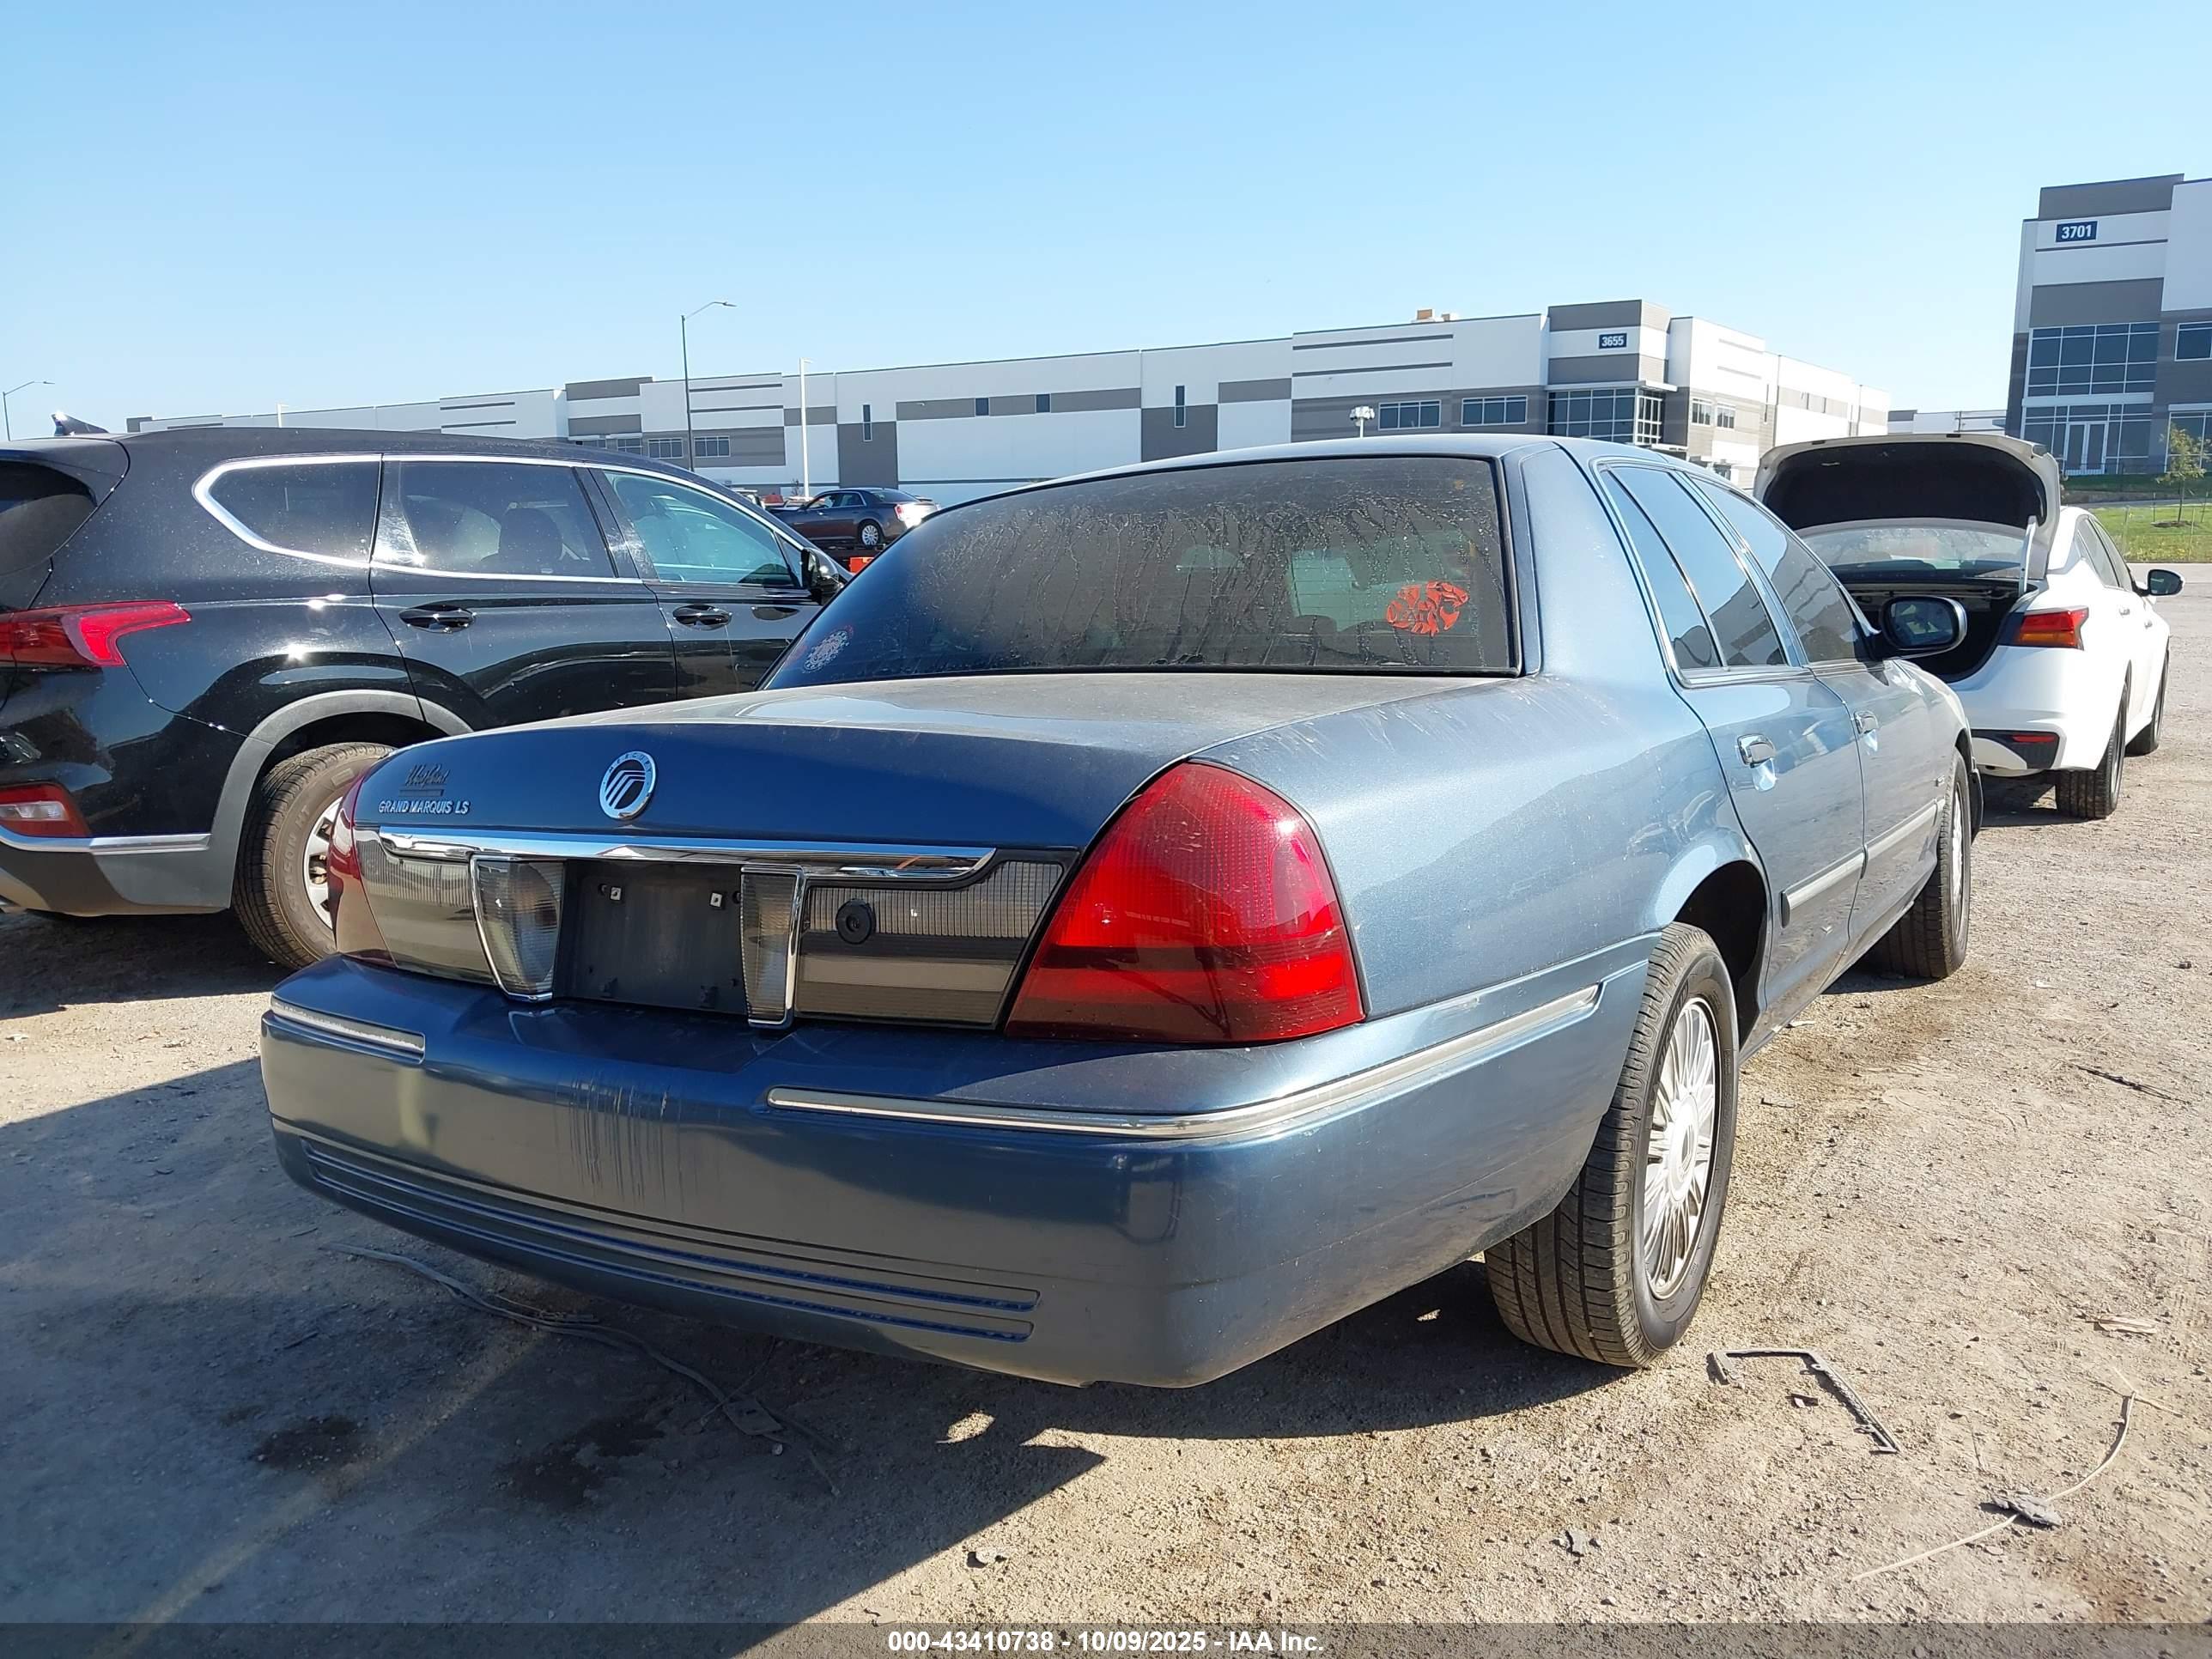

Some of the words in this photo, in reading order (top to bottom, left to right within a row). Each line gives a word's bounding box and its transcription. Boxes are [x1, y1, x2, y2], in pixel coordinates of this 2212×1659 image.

[2061, 224, 2092, 240] 3701
[1601, 336, 1625, 347] 3655
[378, 800, 410, 813] GRAND
[409, 800, 453, 815] MARQUIS
[454, 800, 471, 815] LS
